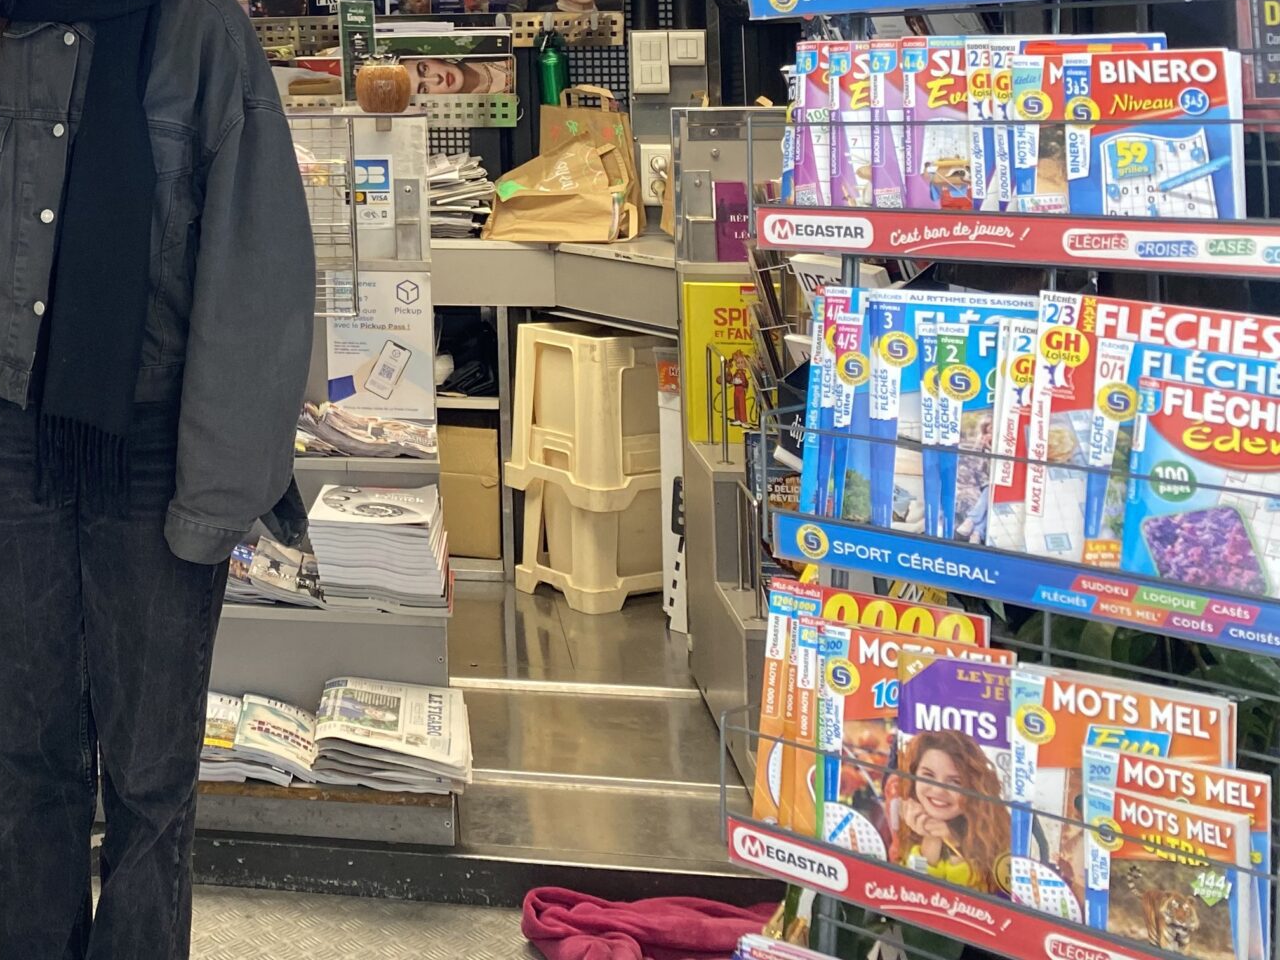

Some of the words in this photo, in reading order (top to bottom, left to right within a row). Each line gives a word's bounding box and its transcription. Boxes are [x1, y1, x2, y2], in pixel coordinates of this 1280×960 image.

[1099, 59, 1218, 85] BINERO
[1108, 93, 1175, 116] Niveau
[1070, 132, 1080, 174] BINERO
[1116, 140, 1148, 169] 59
[1118, 165, 1149, 177] grilles
[772, 217, 865, 240] MEGASTAR
[889, 227, 922, 245] C'est
[924, 223, 951, 240] bon
[953, 220, 972, 238] de
[969, 222, 1015, 244] jouer
[1067, 231, 1129, 252] FLÉCHÉS
[1135, 239, 1198, 258] CROISÉS
[1206, 238, 1257, 256] CASÉS
[394, 306, 422, 317] Pickup
[910, 294, 924, 303] AU
[927, 294, 967, 306] RYTHME
[969, 297, 990, 307] DES
[991, 297, 1036, 309] SAISONS
[1044, 293, 1078, 305] FLÉCHÉS
[360, 322, 386, 331] Pickup
[388, 322, 405, 330] Pass
[883, 311, 893, 330] 3
[1046, 304, 1075, 326] 2/3
[836, 333, 858, 351] 4/5
[945, 345, 960, 363] 2
[1045, 330, 1081, 353] GH
[1045, 350, 1081, 364] Loisirs
[1099, 362, 1125, 381] 0/1
[835, 383, 844, 425] FLÉCHÉS
[924, 396, 934, 439] FLÉCHÉS
[940, 396, 950, 440] FLÉCHÉS
[1092, 416, 1104, 460] FLÉCHÉS
[1030, 490, 1042, 514] MAXI
[1158, 482, 1191, 496] pages
[833, 540, 892, 565] SPORT
[898, 550, 996, 584] CÉRÉBRAL
[1081, 579, 1129, 597] SUDOKU
[1142, 591, 1197, 610] LOGIQUE
[1212, 603, 1251, 620] CASÉS
[1040, 591, 1088, 608] FLÉCHÉS
[1099, 602, 1133, 617] MOTS
[1172, 616, 1214, 633] CODÉS
[1229, 627, 1280, 647] CROISÉS
[915, 703, 999, 740] MOTS
[1053, 680, 1140, 725] MOTS
[1150, 699, 1218, 740] MEL'
[427, 708, 444, 740] FIGARO
[1089, 764, 1110, 776] 200
[1123, 757, 1196, 796] MOTS
[1205, 775, 1262, 809] MEL'
[1120, 798, 1180, 835] MOTS
[1186, 819, 1232, 849] MEL'
[740, 834, 840, 881] MEGASTAR
[864, 880, 899, 902] C'est
[899, 888, 929, 908] bon
[930, 897, 951, 914] de
[948, 900, 997, 927] jouer
[1197, 872, 1227, 889] 144
